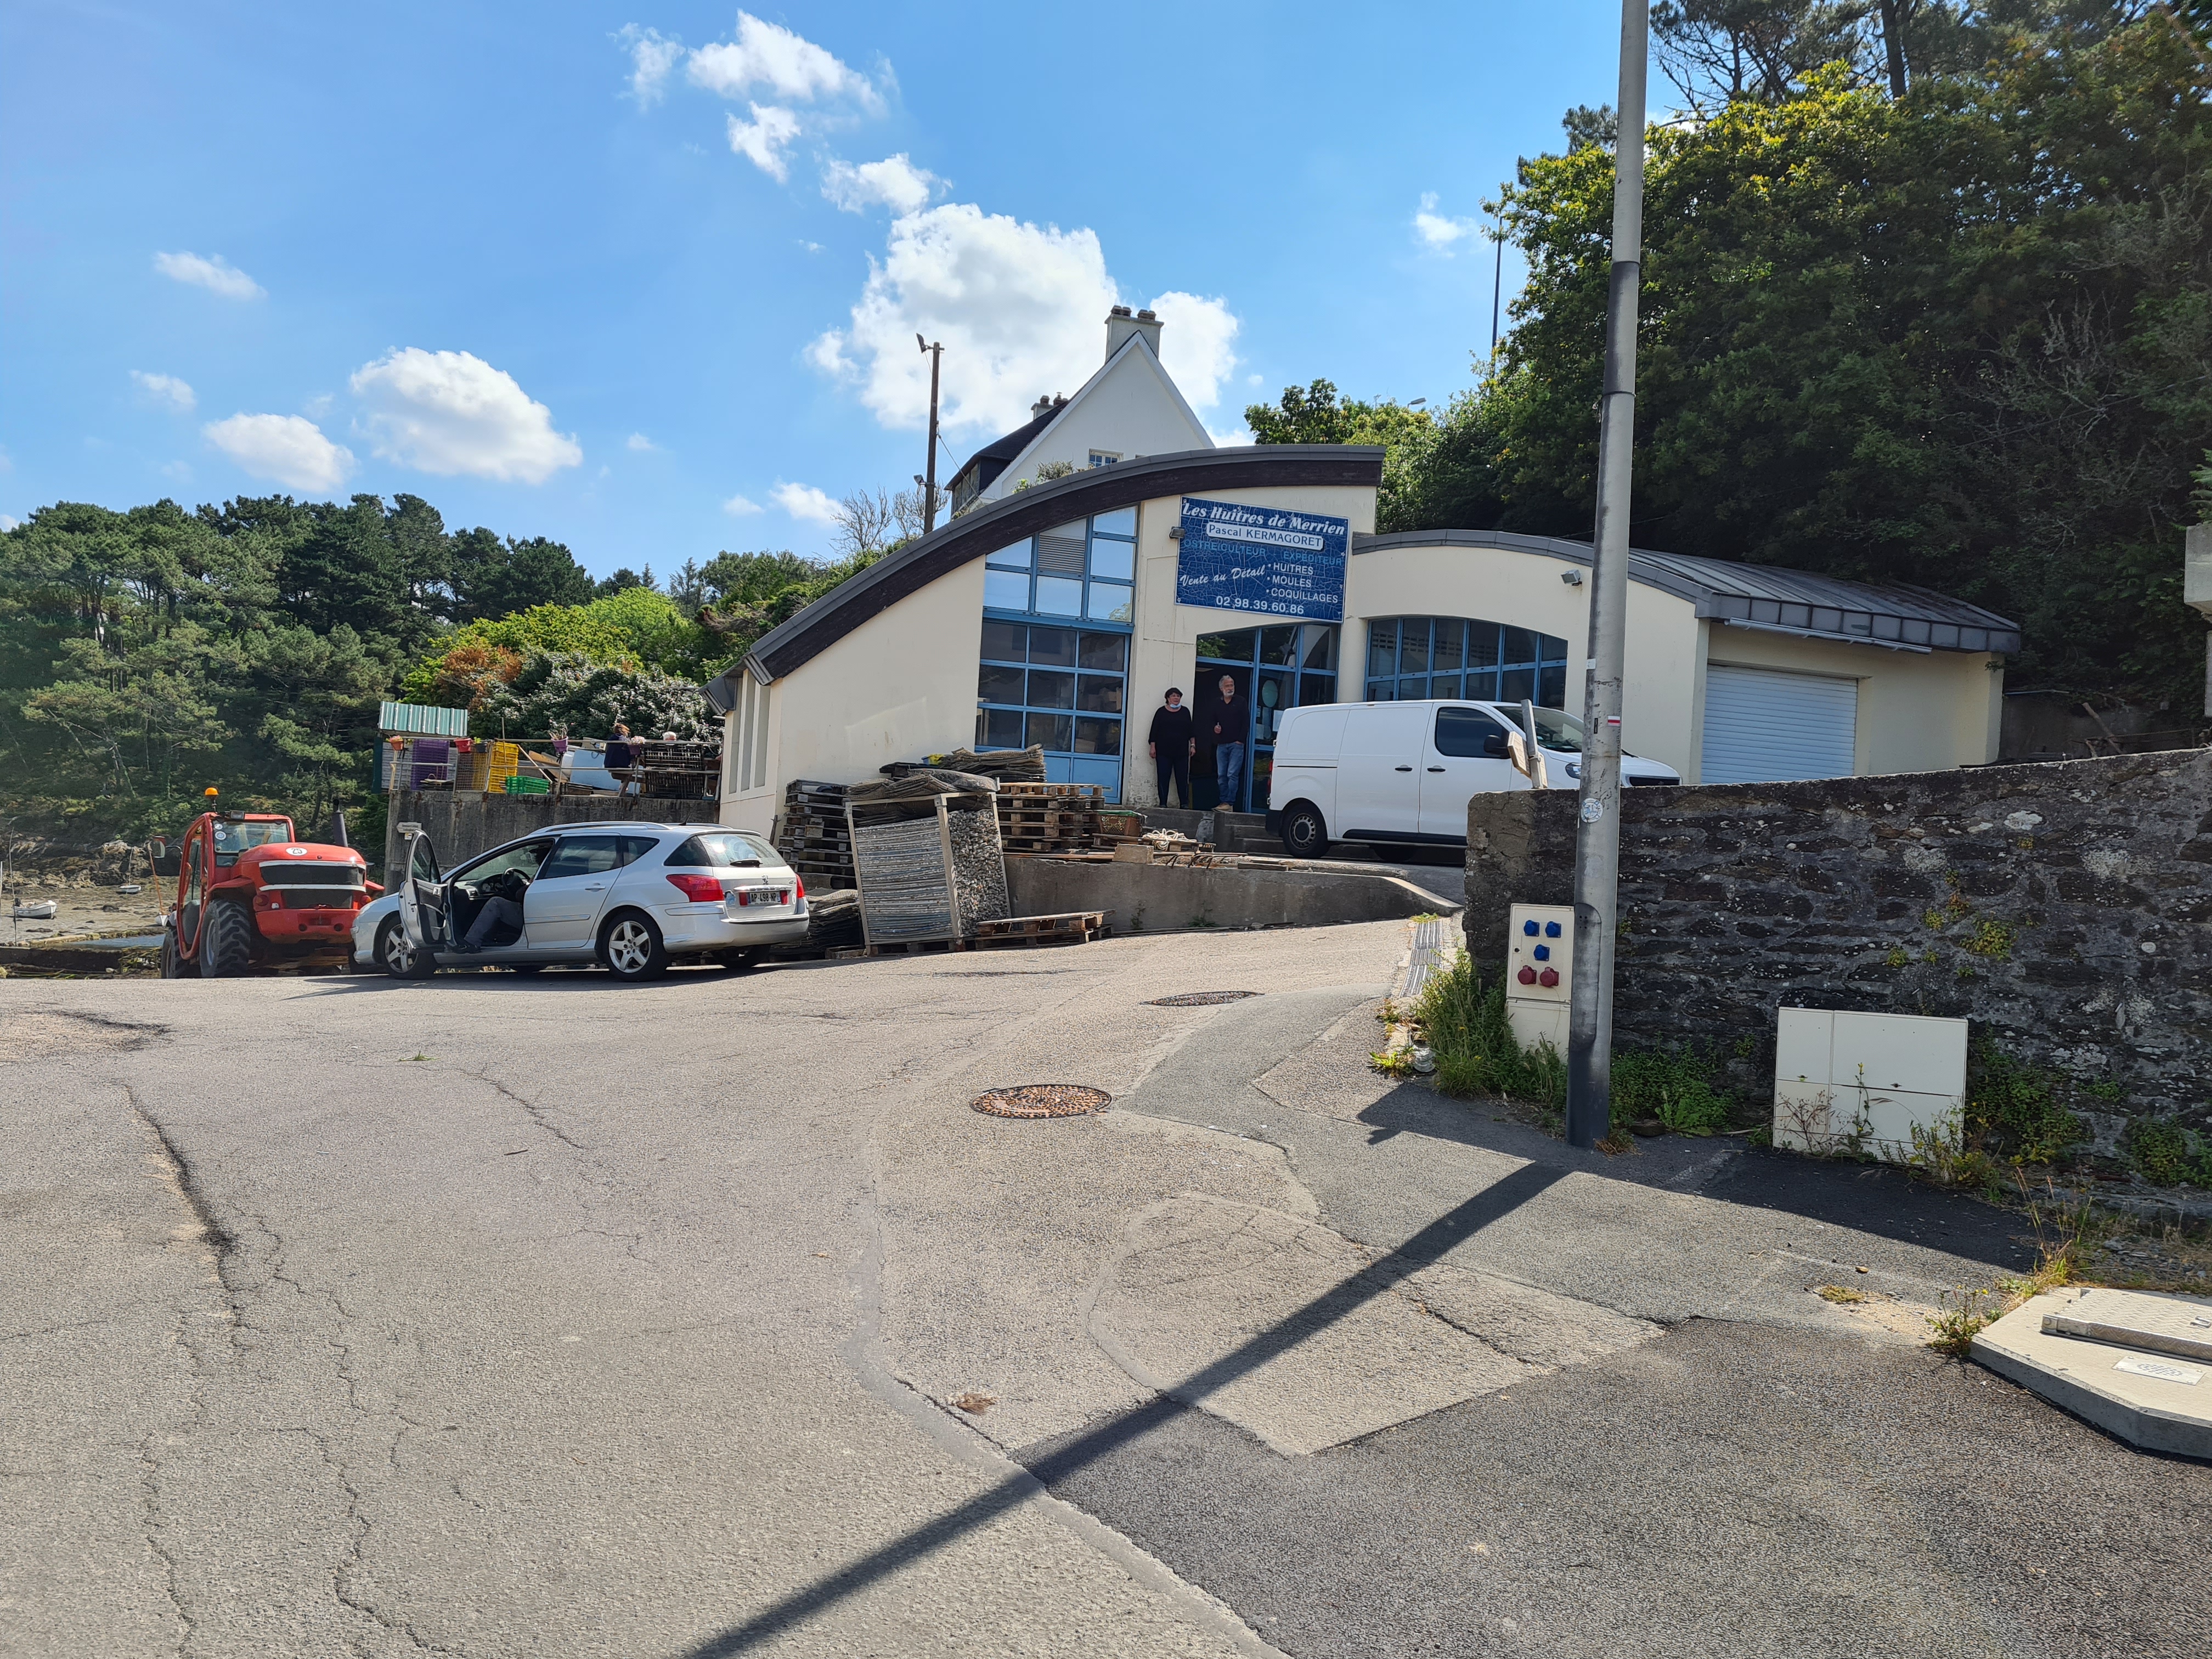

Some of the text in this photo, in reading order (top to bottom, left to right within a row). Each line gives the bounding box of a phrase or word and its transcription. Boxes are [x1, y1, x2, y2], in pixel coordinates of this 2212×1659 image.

[1182, 503, 1207, 517] Les
[1268, 514, 1286, 527] de
[1289, 517, 1345, 535] Merrien
[1209, 524, 1322, 546] Pascal KERMAGORET
[1184, 539, 1266, 555] OSTREICULTEUR
[1180, 574, 1209, 586] Vente
[1231, 564, 1266, 579] Détail
[1272, 574, 1312, 588] MOULES
[1271, 588, 1338, 603] COQUILLAGES
